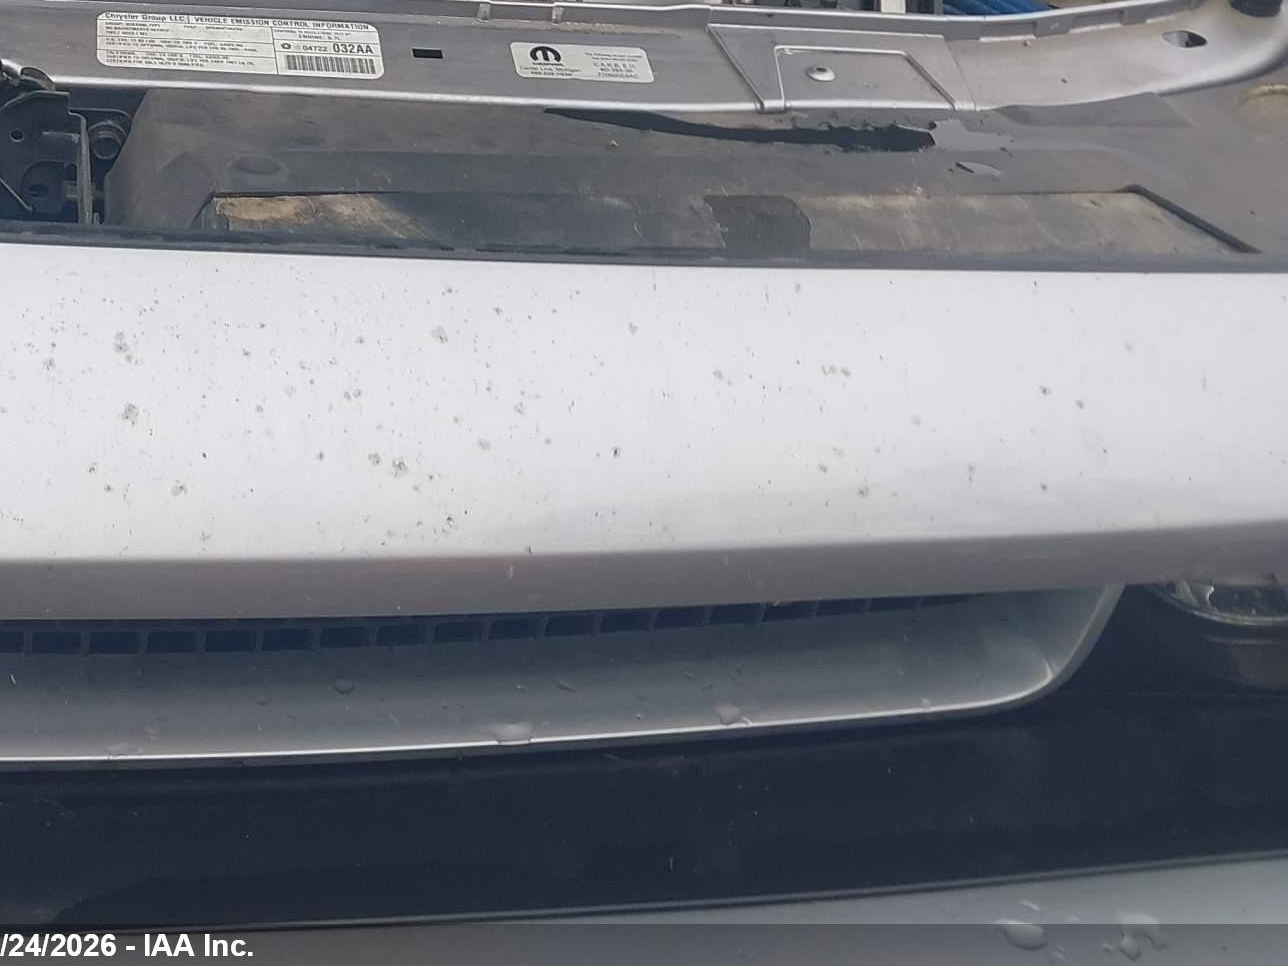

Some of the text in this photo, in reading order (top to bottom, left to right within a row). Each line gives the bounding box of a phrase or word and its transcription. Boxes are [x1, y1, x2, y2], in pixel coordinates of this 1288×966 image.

[105, 12, 139, 21] Chrysler
[142, 13, 166, 22] Group
[194, 16, 369, 30] VEHICLE EMISSION CONTROL INFORMATION
[332, 43, 374, 54] 032AA
